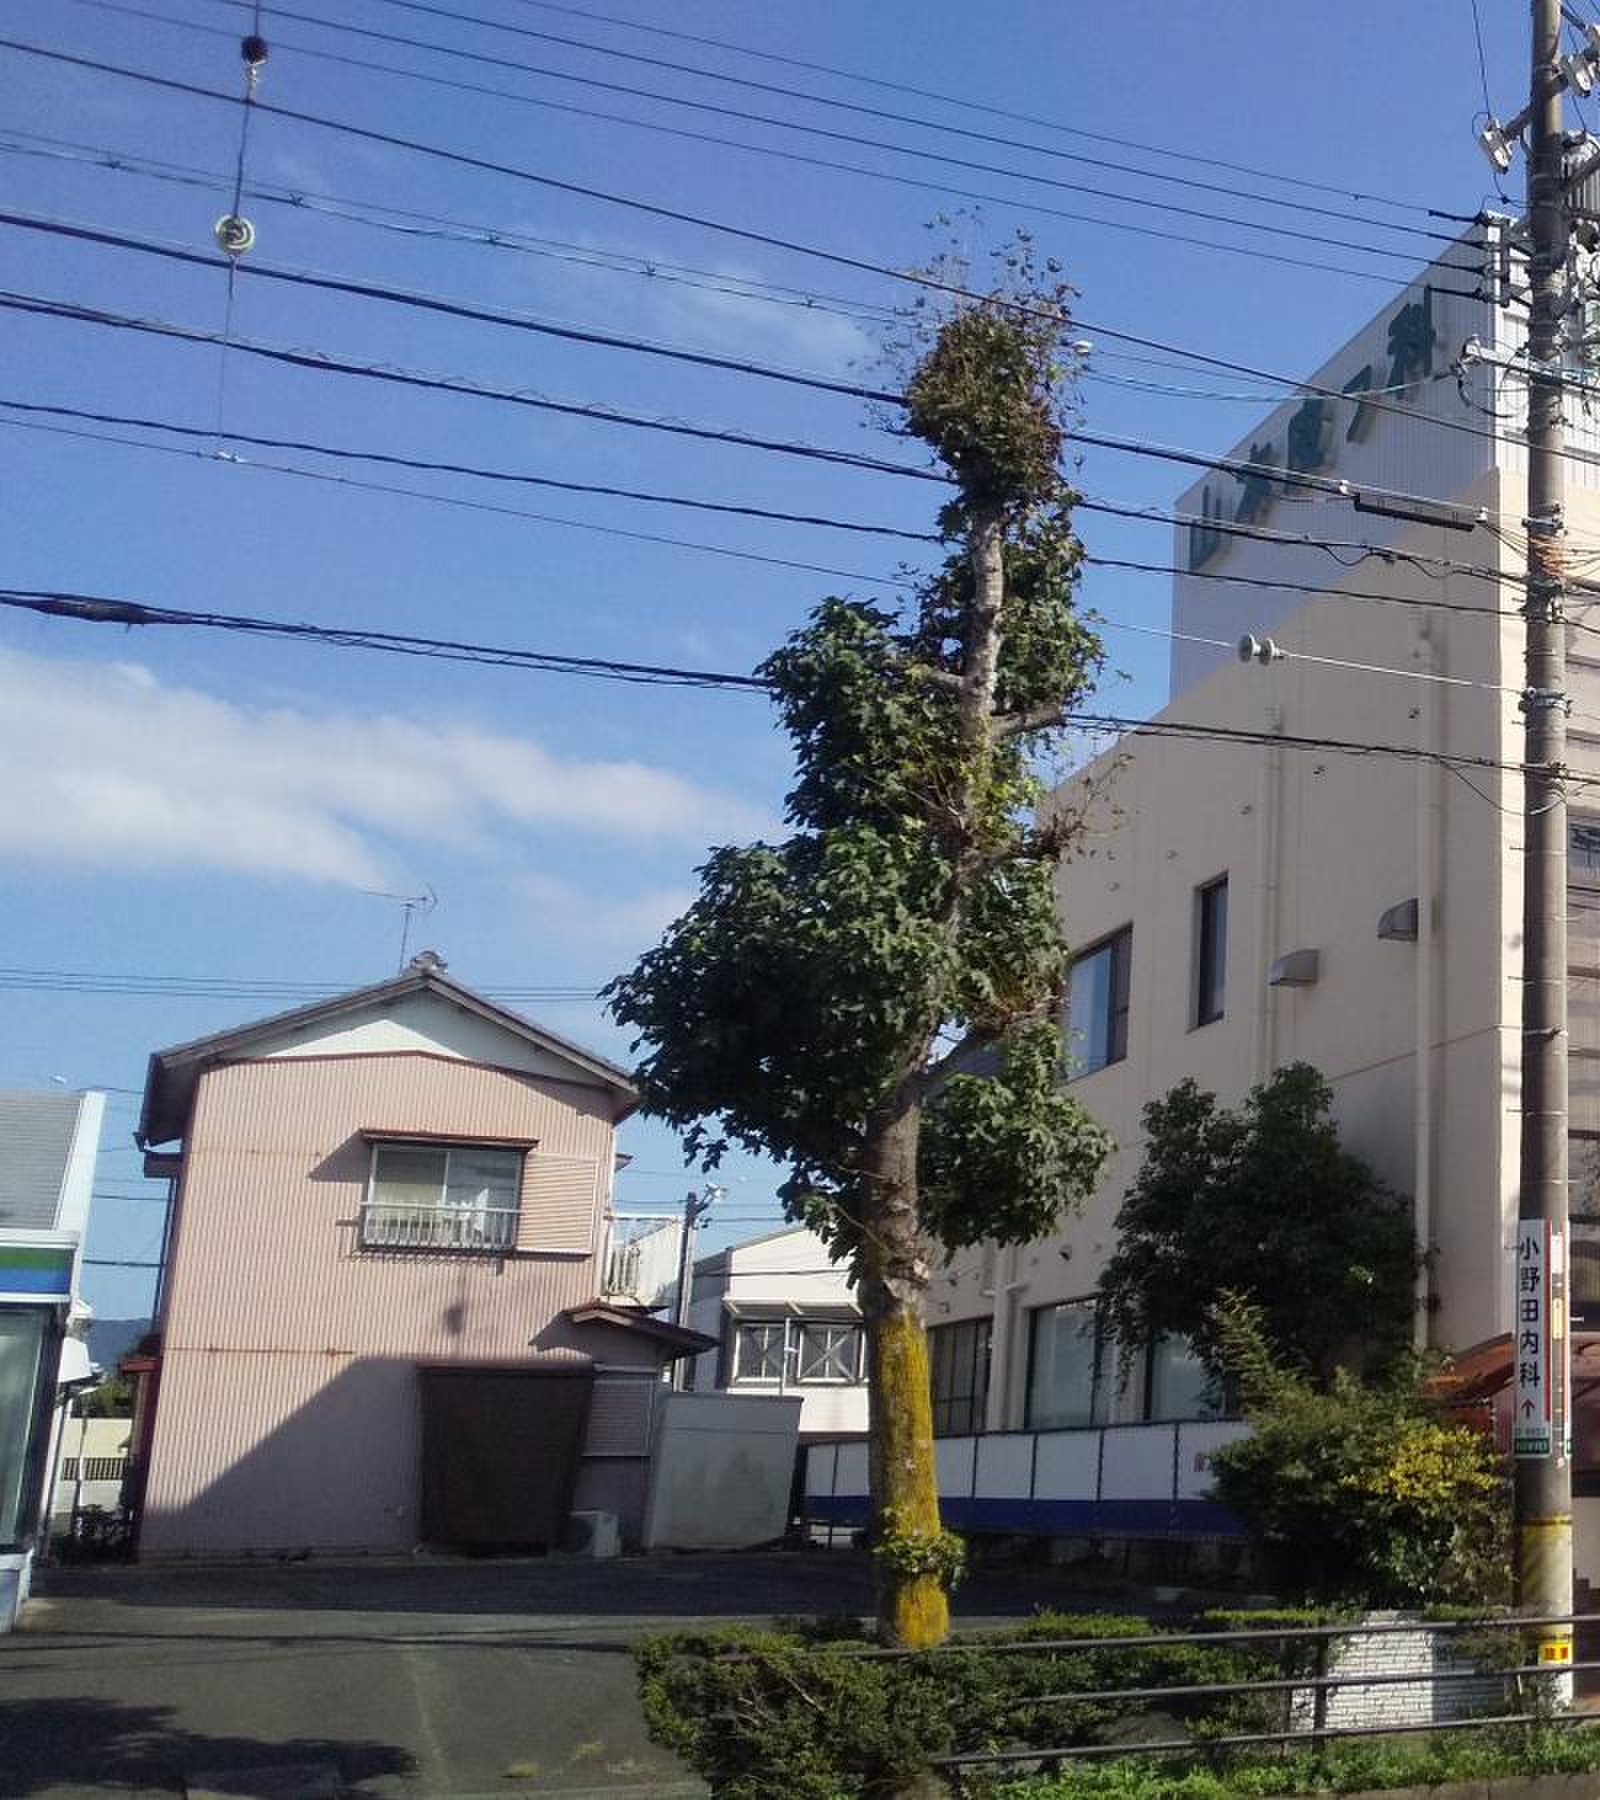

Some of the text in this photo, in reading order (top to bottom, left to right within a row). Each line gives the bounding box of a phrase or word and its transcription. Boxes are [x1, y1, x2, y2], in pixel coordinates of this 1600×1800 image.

[1520, 1236, 1540, 1388] 小野田内科
